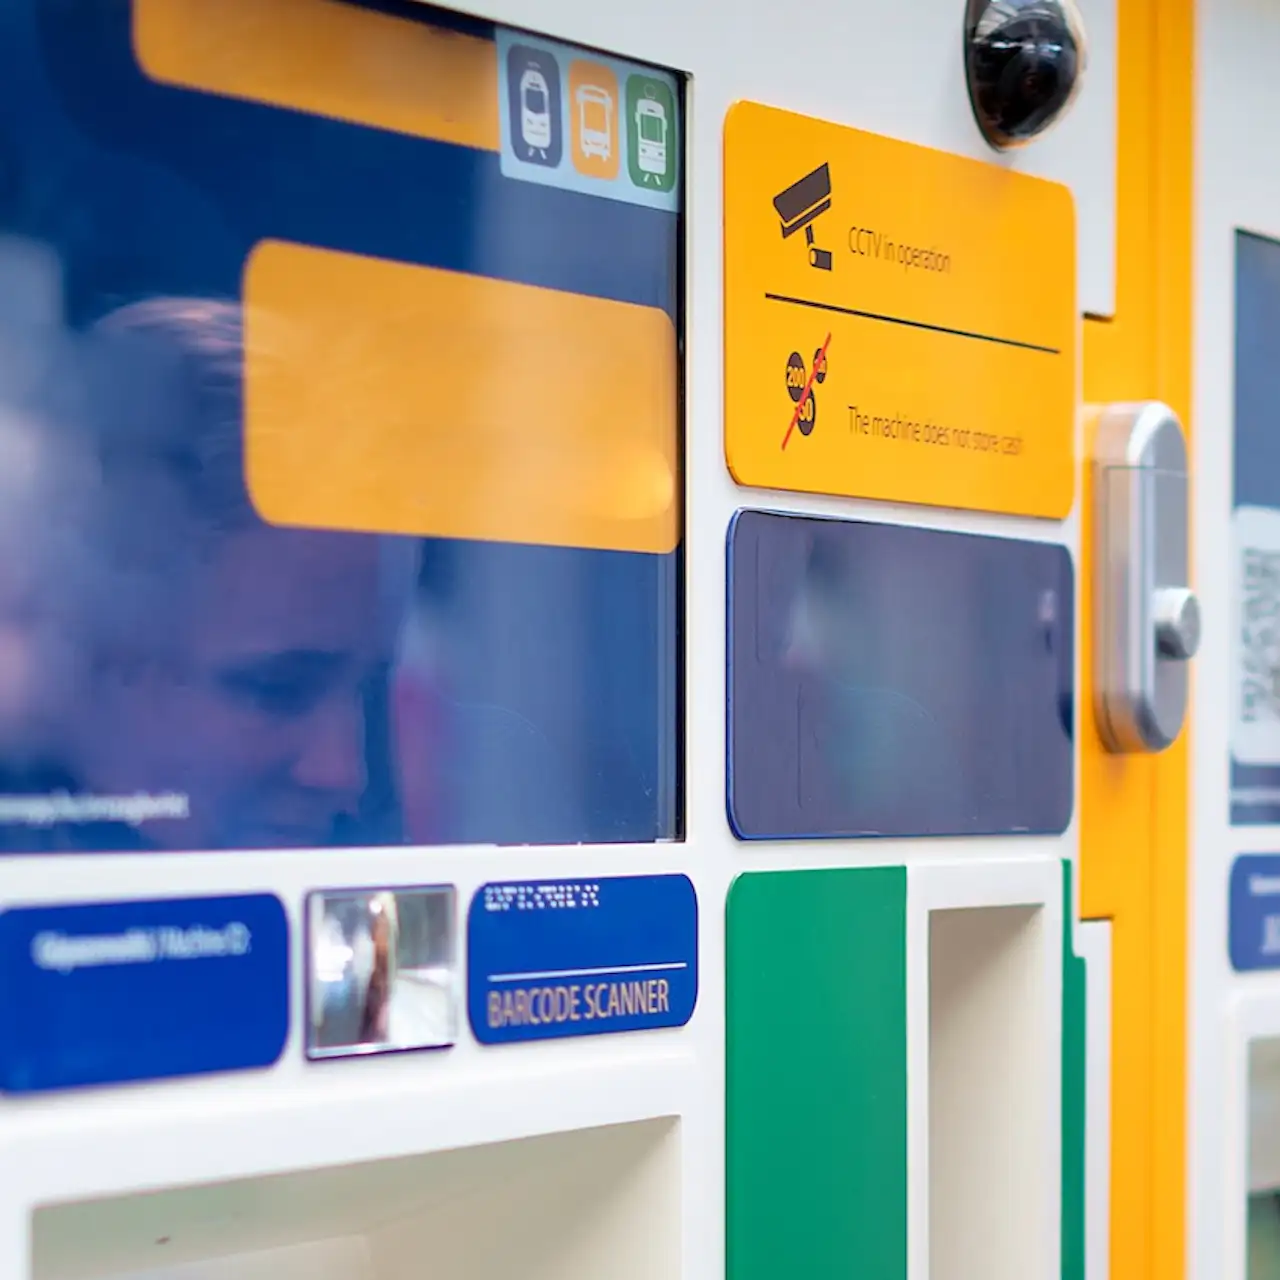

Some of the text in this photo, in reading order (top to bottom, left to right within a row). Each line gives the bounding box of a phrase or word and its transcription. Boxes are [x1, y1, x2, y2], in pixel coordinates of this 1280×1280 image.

[848, 225, 951, 275] CCTV in operation
[786, 365, 806, 388] 200
[848, 405, 869, 435] The
[872, 411, 921, 443] machine
[924, 418, 949, 446] does
[952, 425, 971, 449] not
[487, 978, 670, 1029] BARCODE SCANNER
